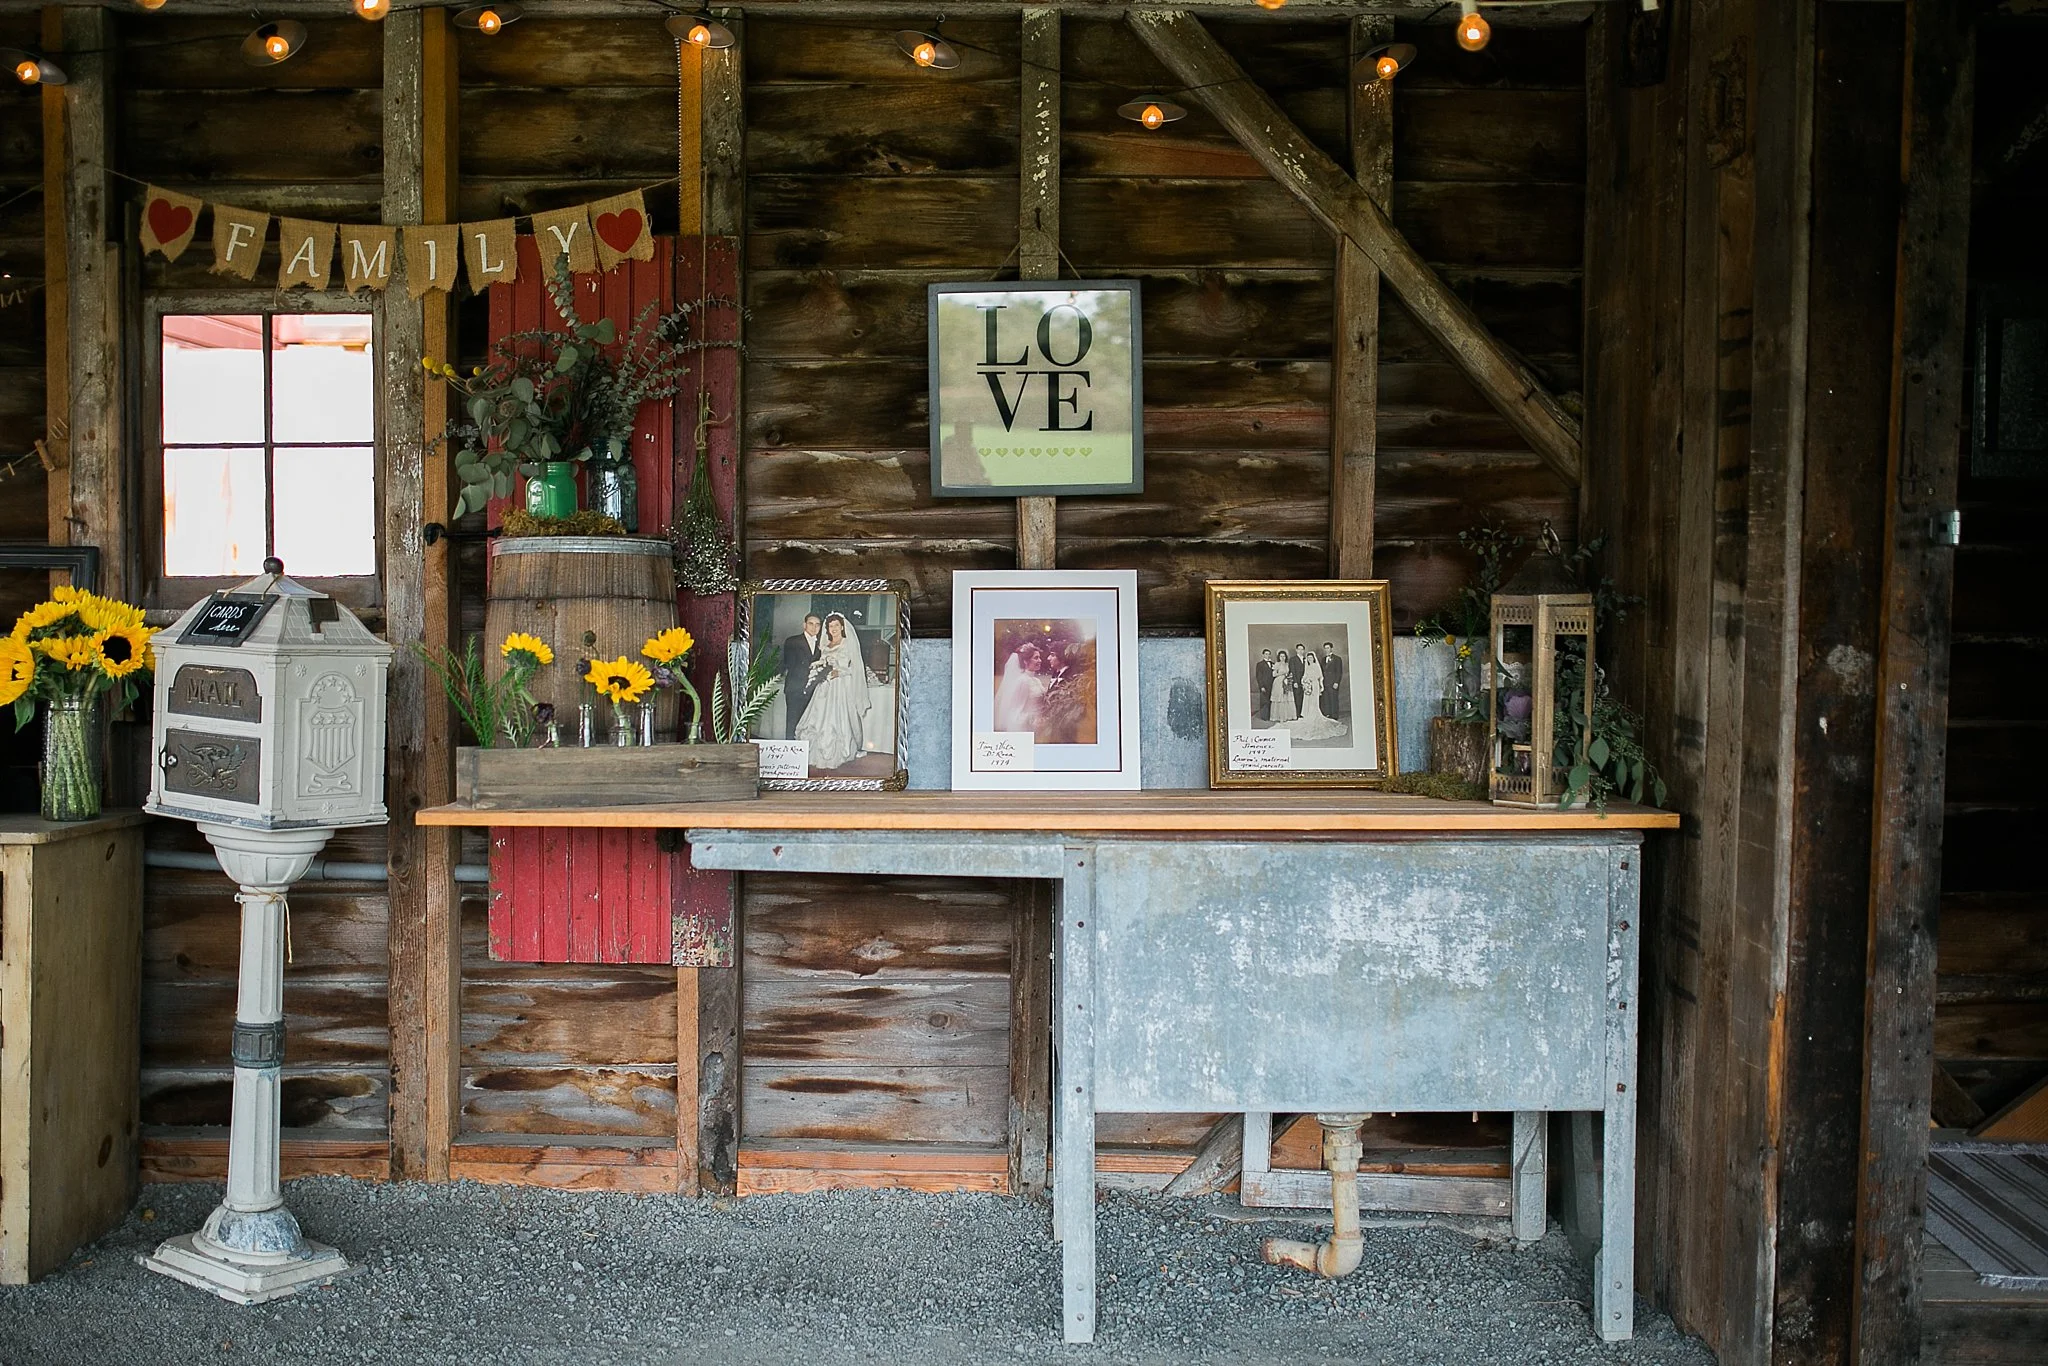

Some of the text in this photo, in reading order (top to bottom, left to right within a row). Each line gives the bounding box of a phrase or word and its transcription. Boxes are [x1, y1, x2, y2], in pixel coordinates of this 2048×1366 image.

[225, 222, 578, 280] FAMILY
[210, 606, 247, 619] CARDS
[209, 619, 240, 631] here
[187, 678, 242, 707] MAIL
